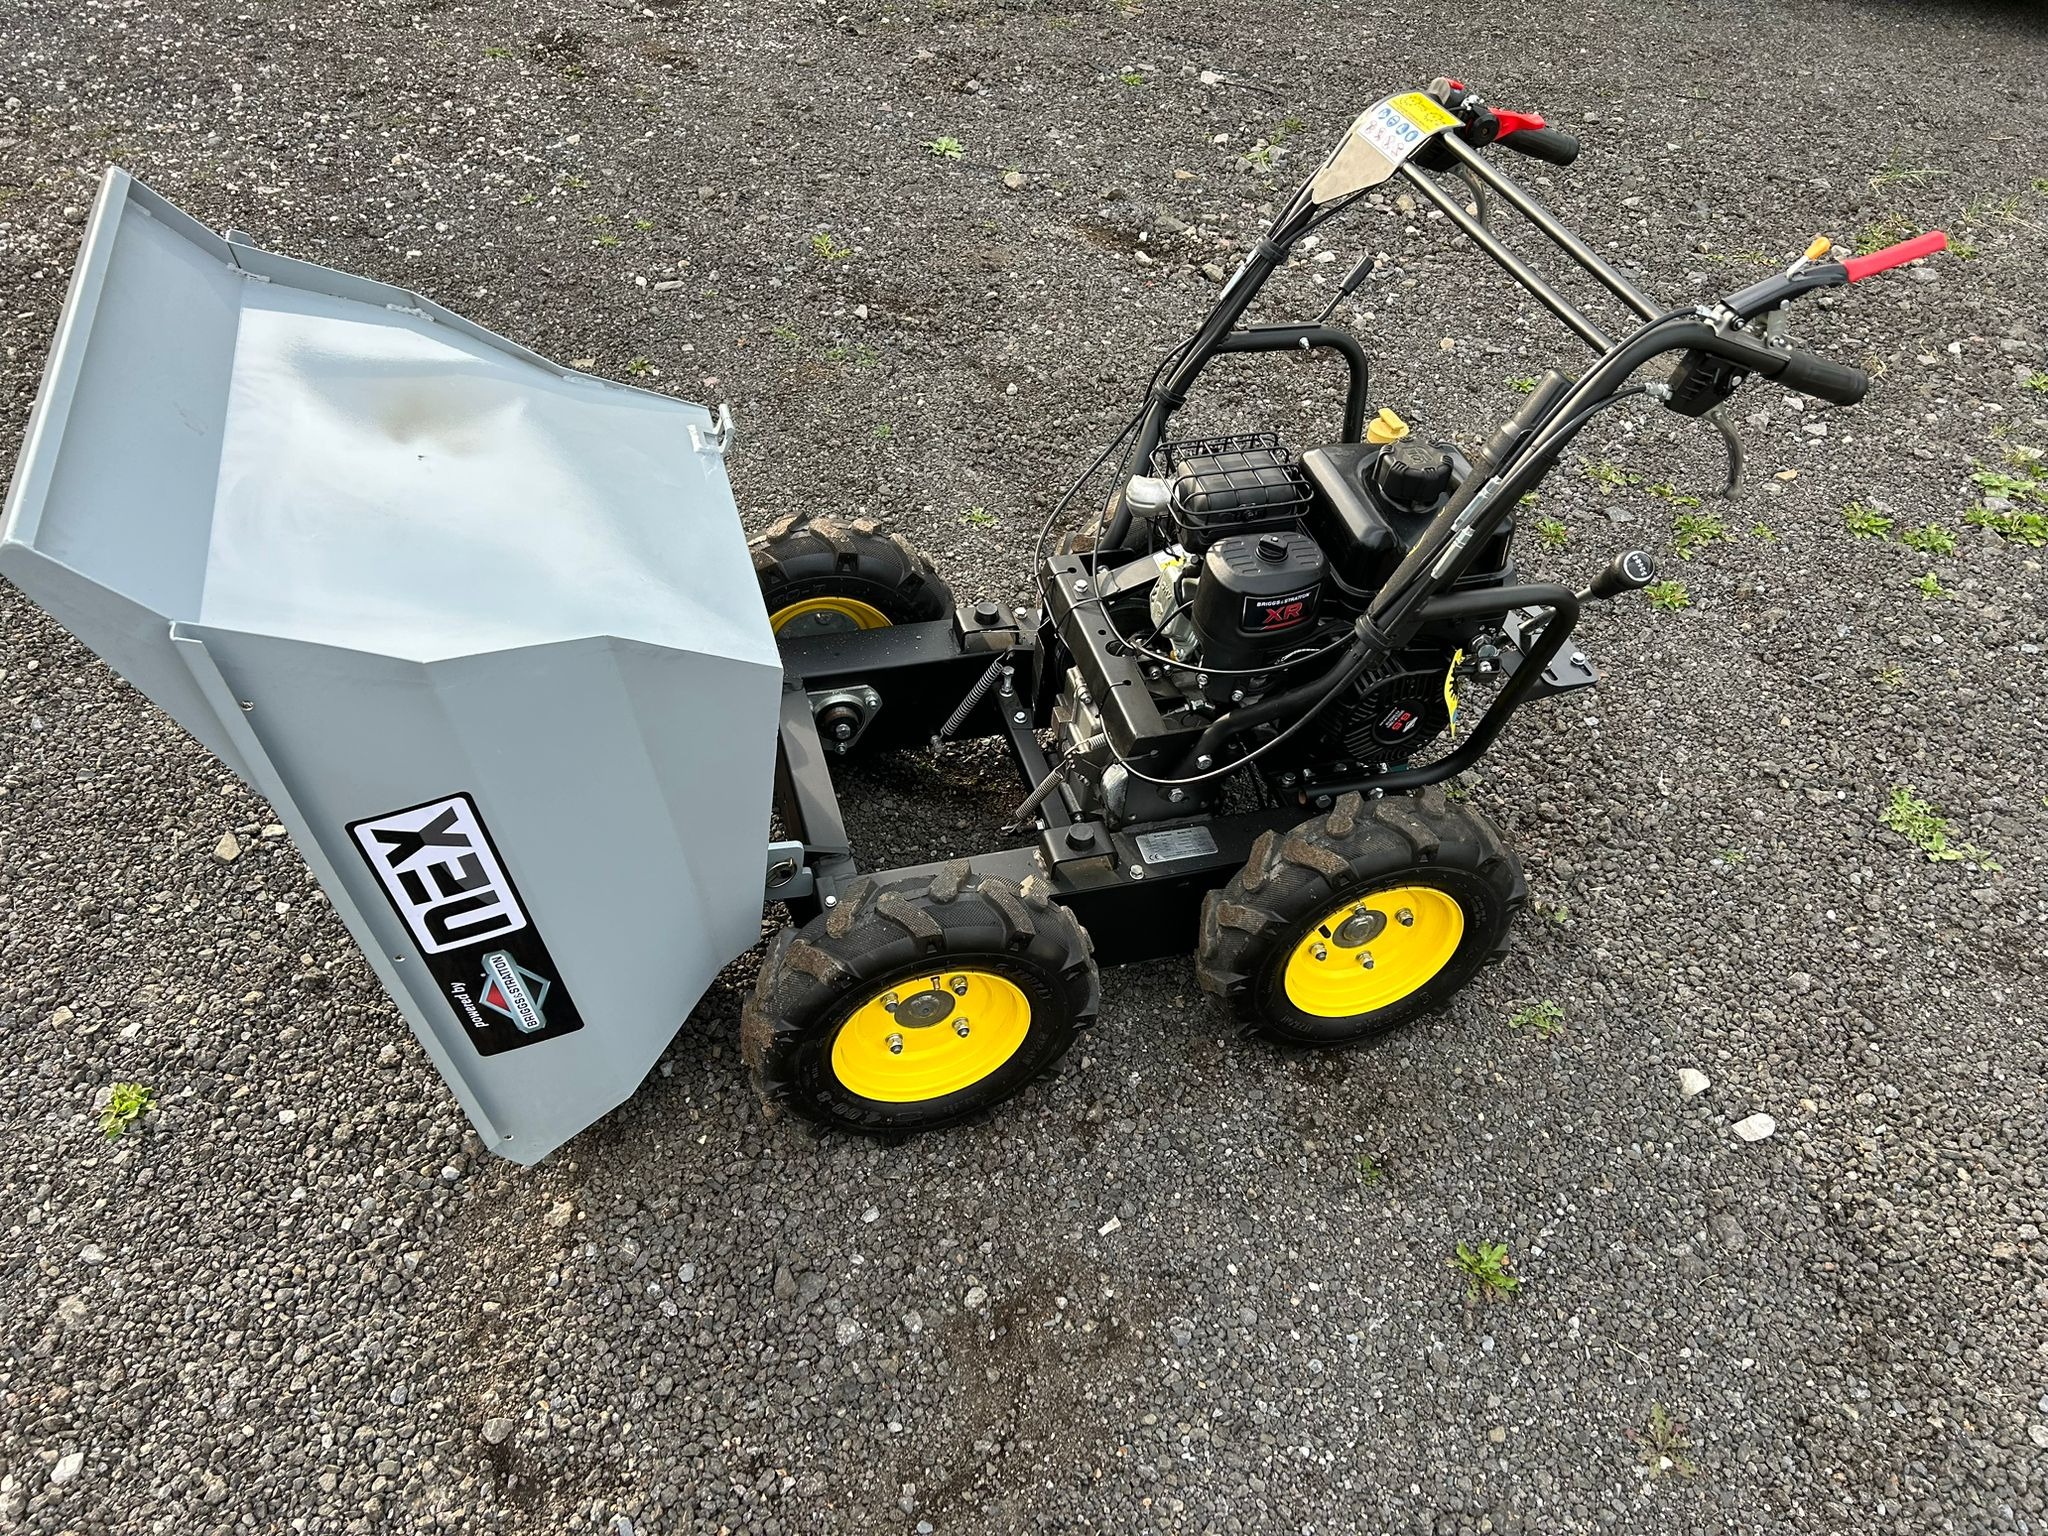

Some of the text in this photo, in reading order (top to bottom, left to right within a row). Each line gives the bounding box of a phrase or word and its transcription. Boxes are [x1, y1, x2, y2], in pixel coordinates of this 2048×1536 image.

[1262, 602, 1303, 624] XR
[450, 981, 490, 1029] powered by
